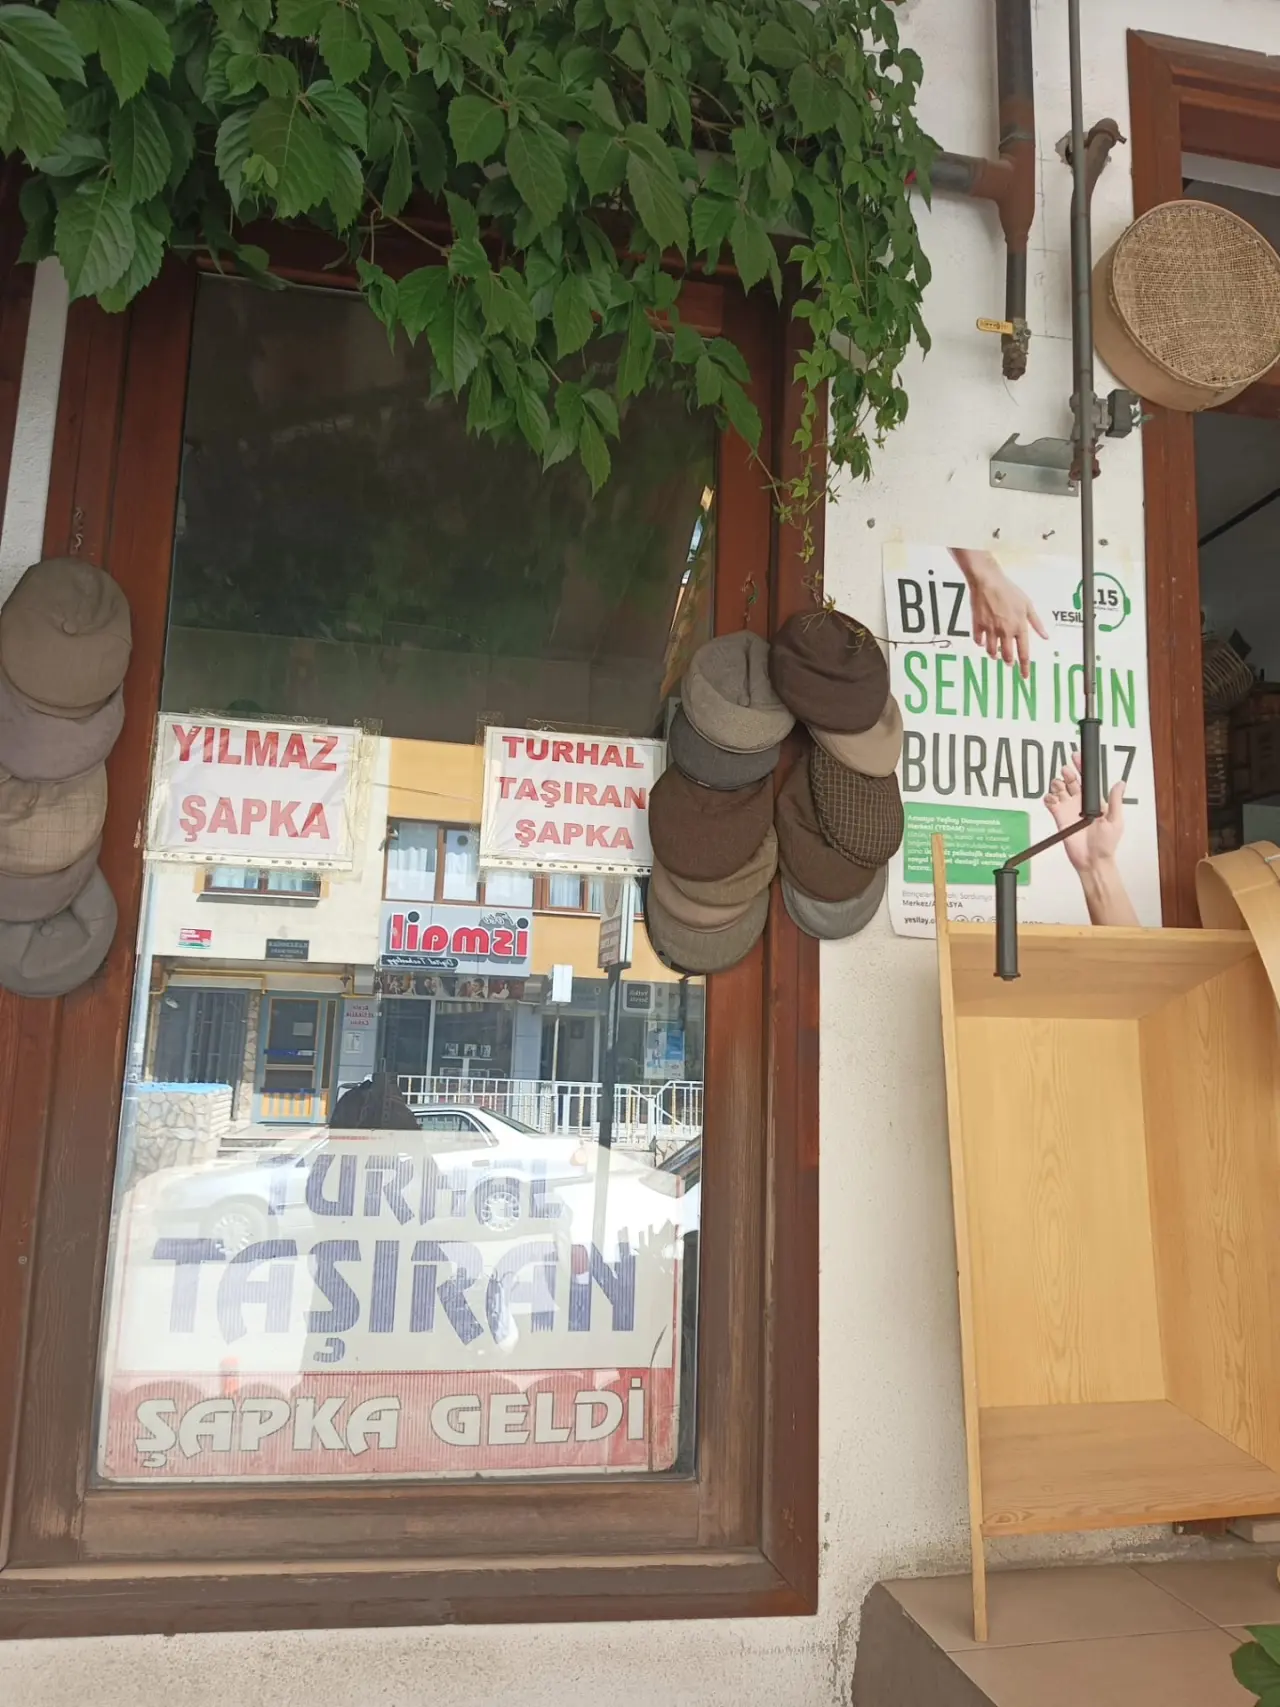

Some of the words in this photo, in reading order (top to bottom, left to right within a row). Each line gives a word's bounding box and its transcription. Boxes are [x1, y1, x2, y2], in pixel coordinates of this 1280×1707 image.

[897, 569, 970, 637] BİZ
[1092, 588, 1119, 607] 15
[904, 647, 1037, 721] SENİN
[172, 724, 338, 771] YILMAZ
[502, 736, 644, 768] TURHAL
[902, 730, 1138, 805] BURADAIZ
[496, 776, 647, 809] TAŞIRAN
[178, 795, 330, 842] ŞAPKA
[515, 819, 634, 849] ŞAPKA
[151, 1237, 636, 1363] TAŞIRAN
[135, 1396, 401, 1469] ŞAPKA
[430, 1376, 646, 1447] GELDİ
